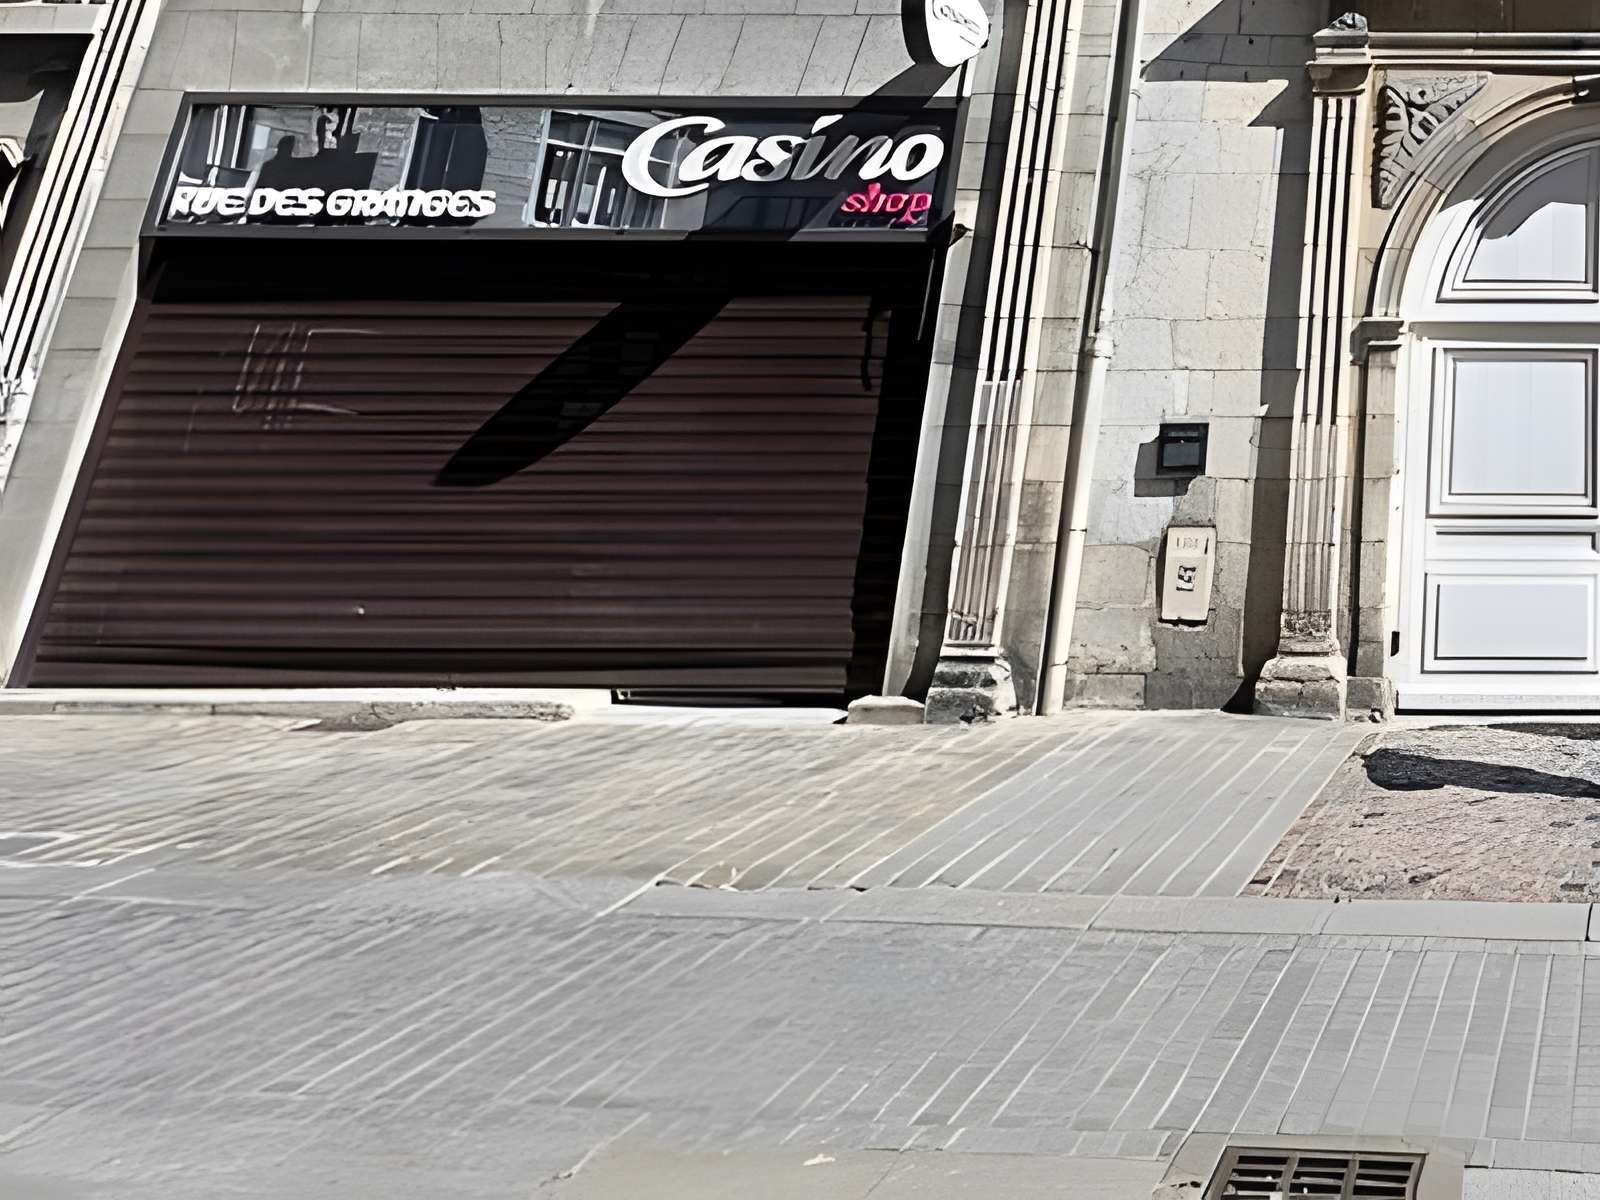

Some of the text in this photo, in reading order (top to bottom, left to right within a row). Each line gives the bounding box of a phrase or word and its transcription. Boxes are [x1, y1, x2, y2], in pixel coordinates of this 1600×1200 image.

[622, 115, 945, 197] Casino
[168, 187, 246, 220] RUE
[248, 187, 325, 217] DES
[841, 182, 933, 225] shop
